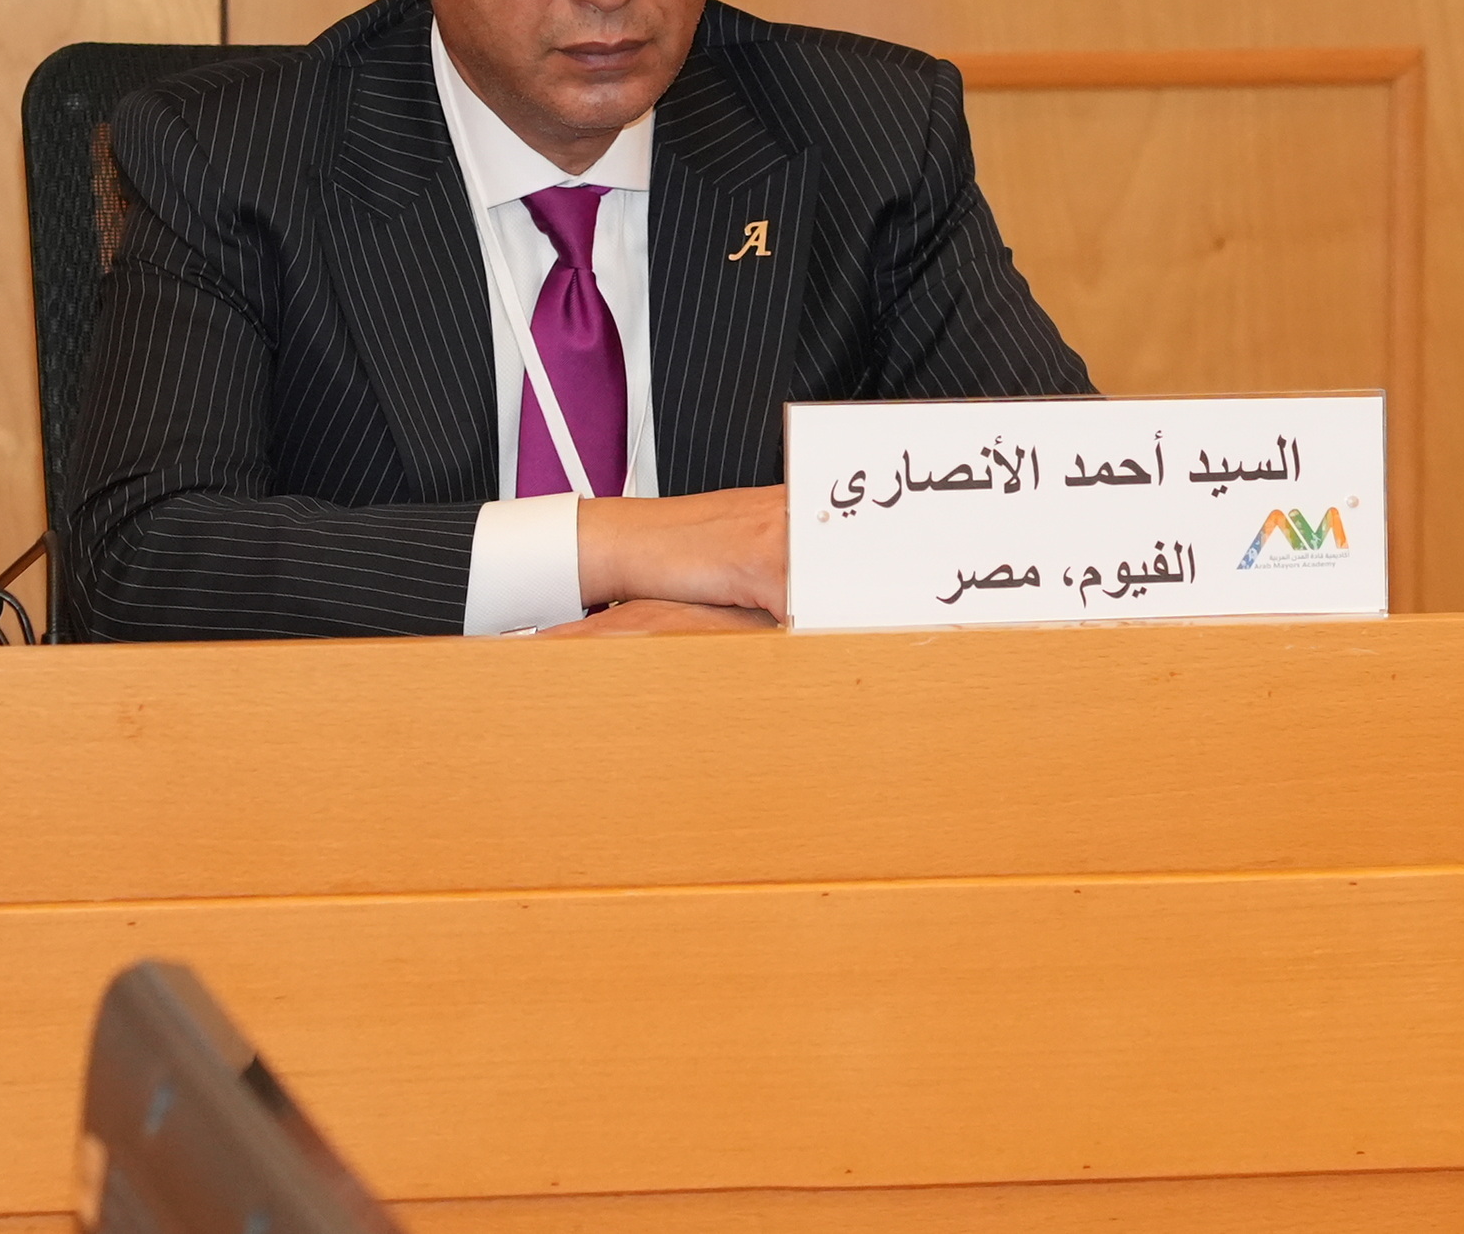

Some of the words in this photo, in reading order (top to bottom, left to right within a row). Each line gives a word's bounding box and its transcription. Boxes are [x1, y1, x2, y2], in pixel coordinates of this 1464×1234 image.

[728, 219, 771, 261] A
[830, 435, 1040, 519] الأنصاري
[1064, 429, 1164, 487] أحمد
[1188, 434, 1301, 498] السيد
[935, 563, 1041, 606] مصر
[1062, 540, 1196, 608] الفيوم،
[1273, 562, 1300, 570] Mayors
[1302, 561, 1336, 569] Academy
